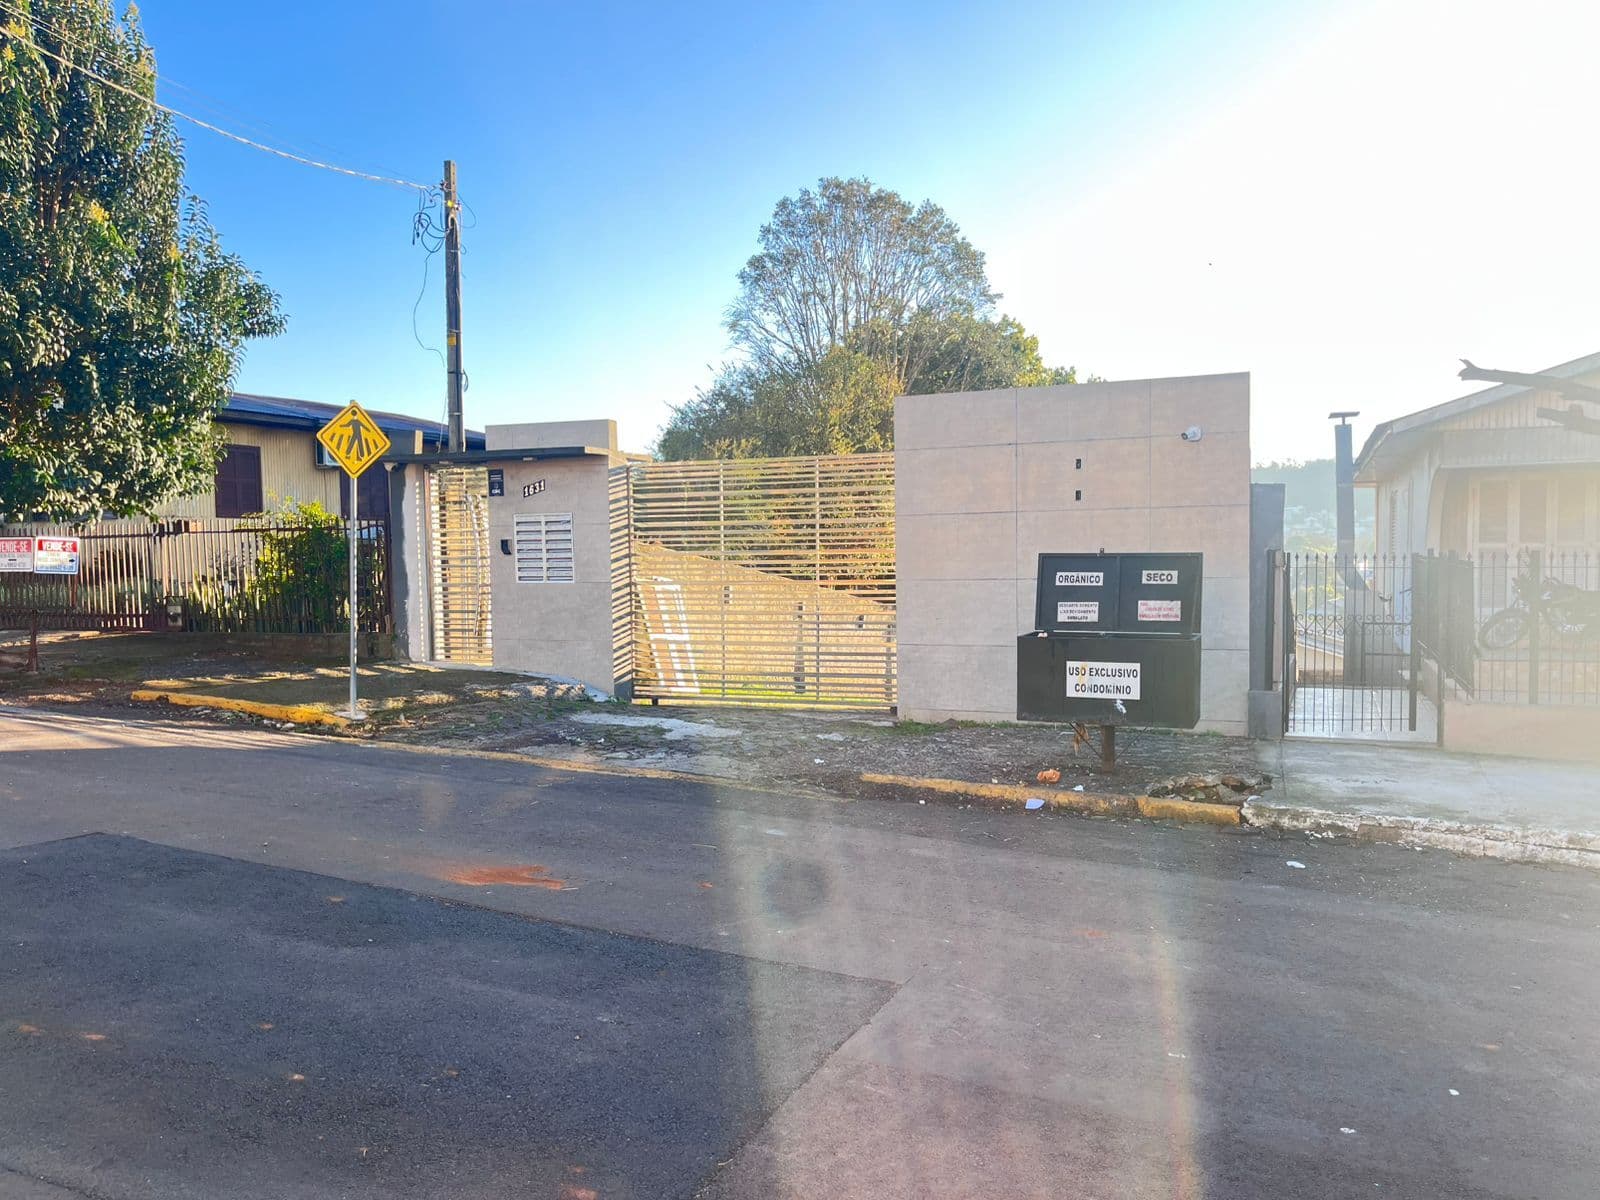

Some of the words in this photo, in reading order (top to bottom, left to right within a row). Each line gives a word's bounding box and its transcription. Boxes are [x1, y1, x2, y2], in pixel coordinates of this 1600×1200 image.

[524, 479, 545, 497] 1631
[42, 540, 74, 552] VENDE-SE
[1145, 572, 1173, 582] SECO
[1068, 666, 1087, 677] USO
[1089, 667, 1139, 679] EXCLUSIVO
[1074, 683, 1132, 695] CONDOMINIO
